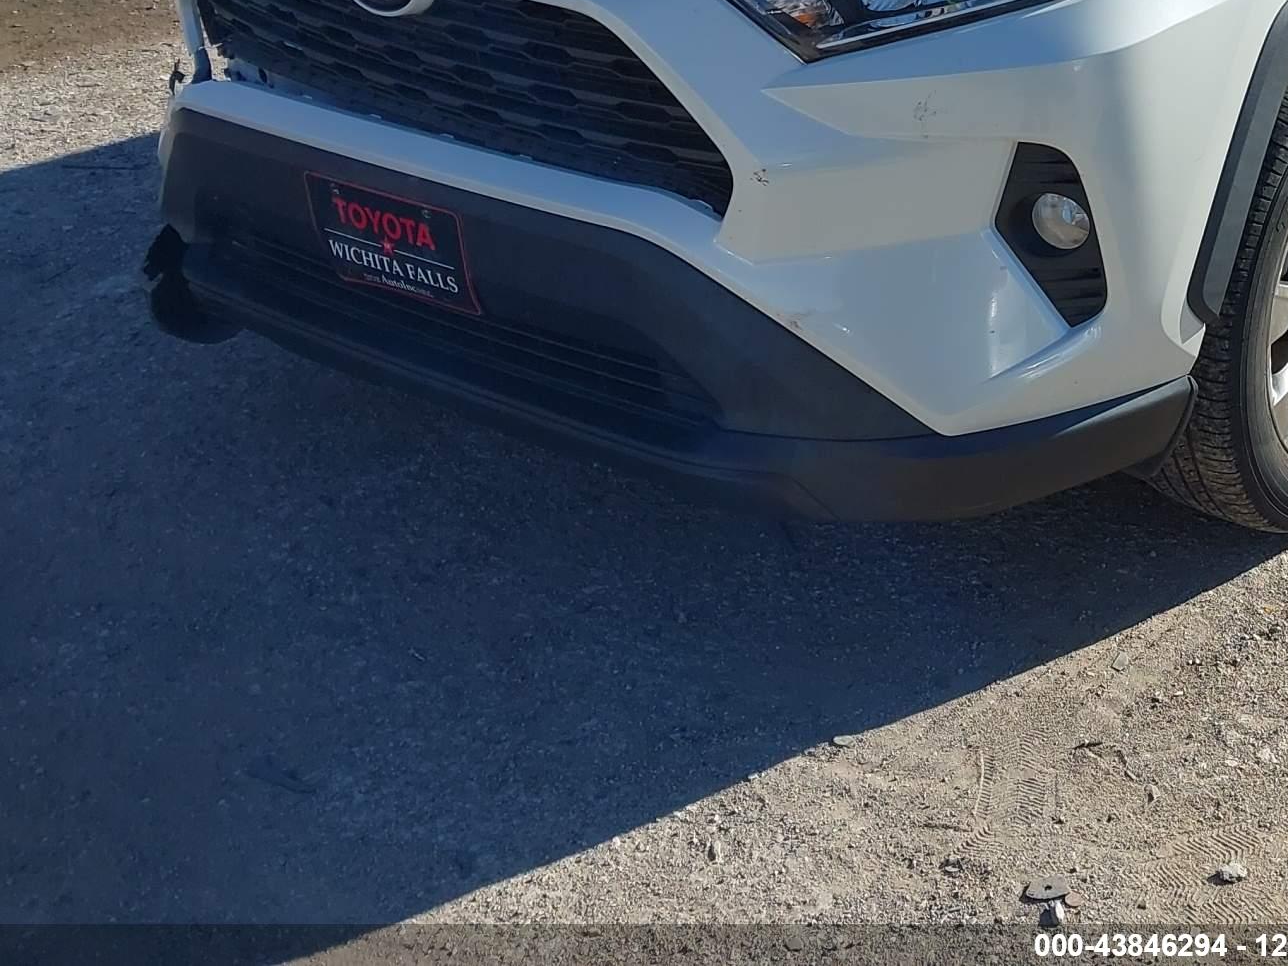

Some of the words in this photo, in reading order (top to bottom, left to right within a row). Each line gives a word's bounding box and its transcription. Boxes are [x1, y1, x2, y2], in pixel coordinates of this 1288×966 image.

[333, 197, 436, 250] TOYOTA
[328, 239, 404, 277] WICHITA
[404, 262, 459, 294] FALLS
